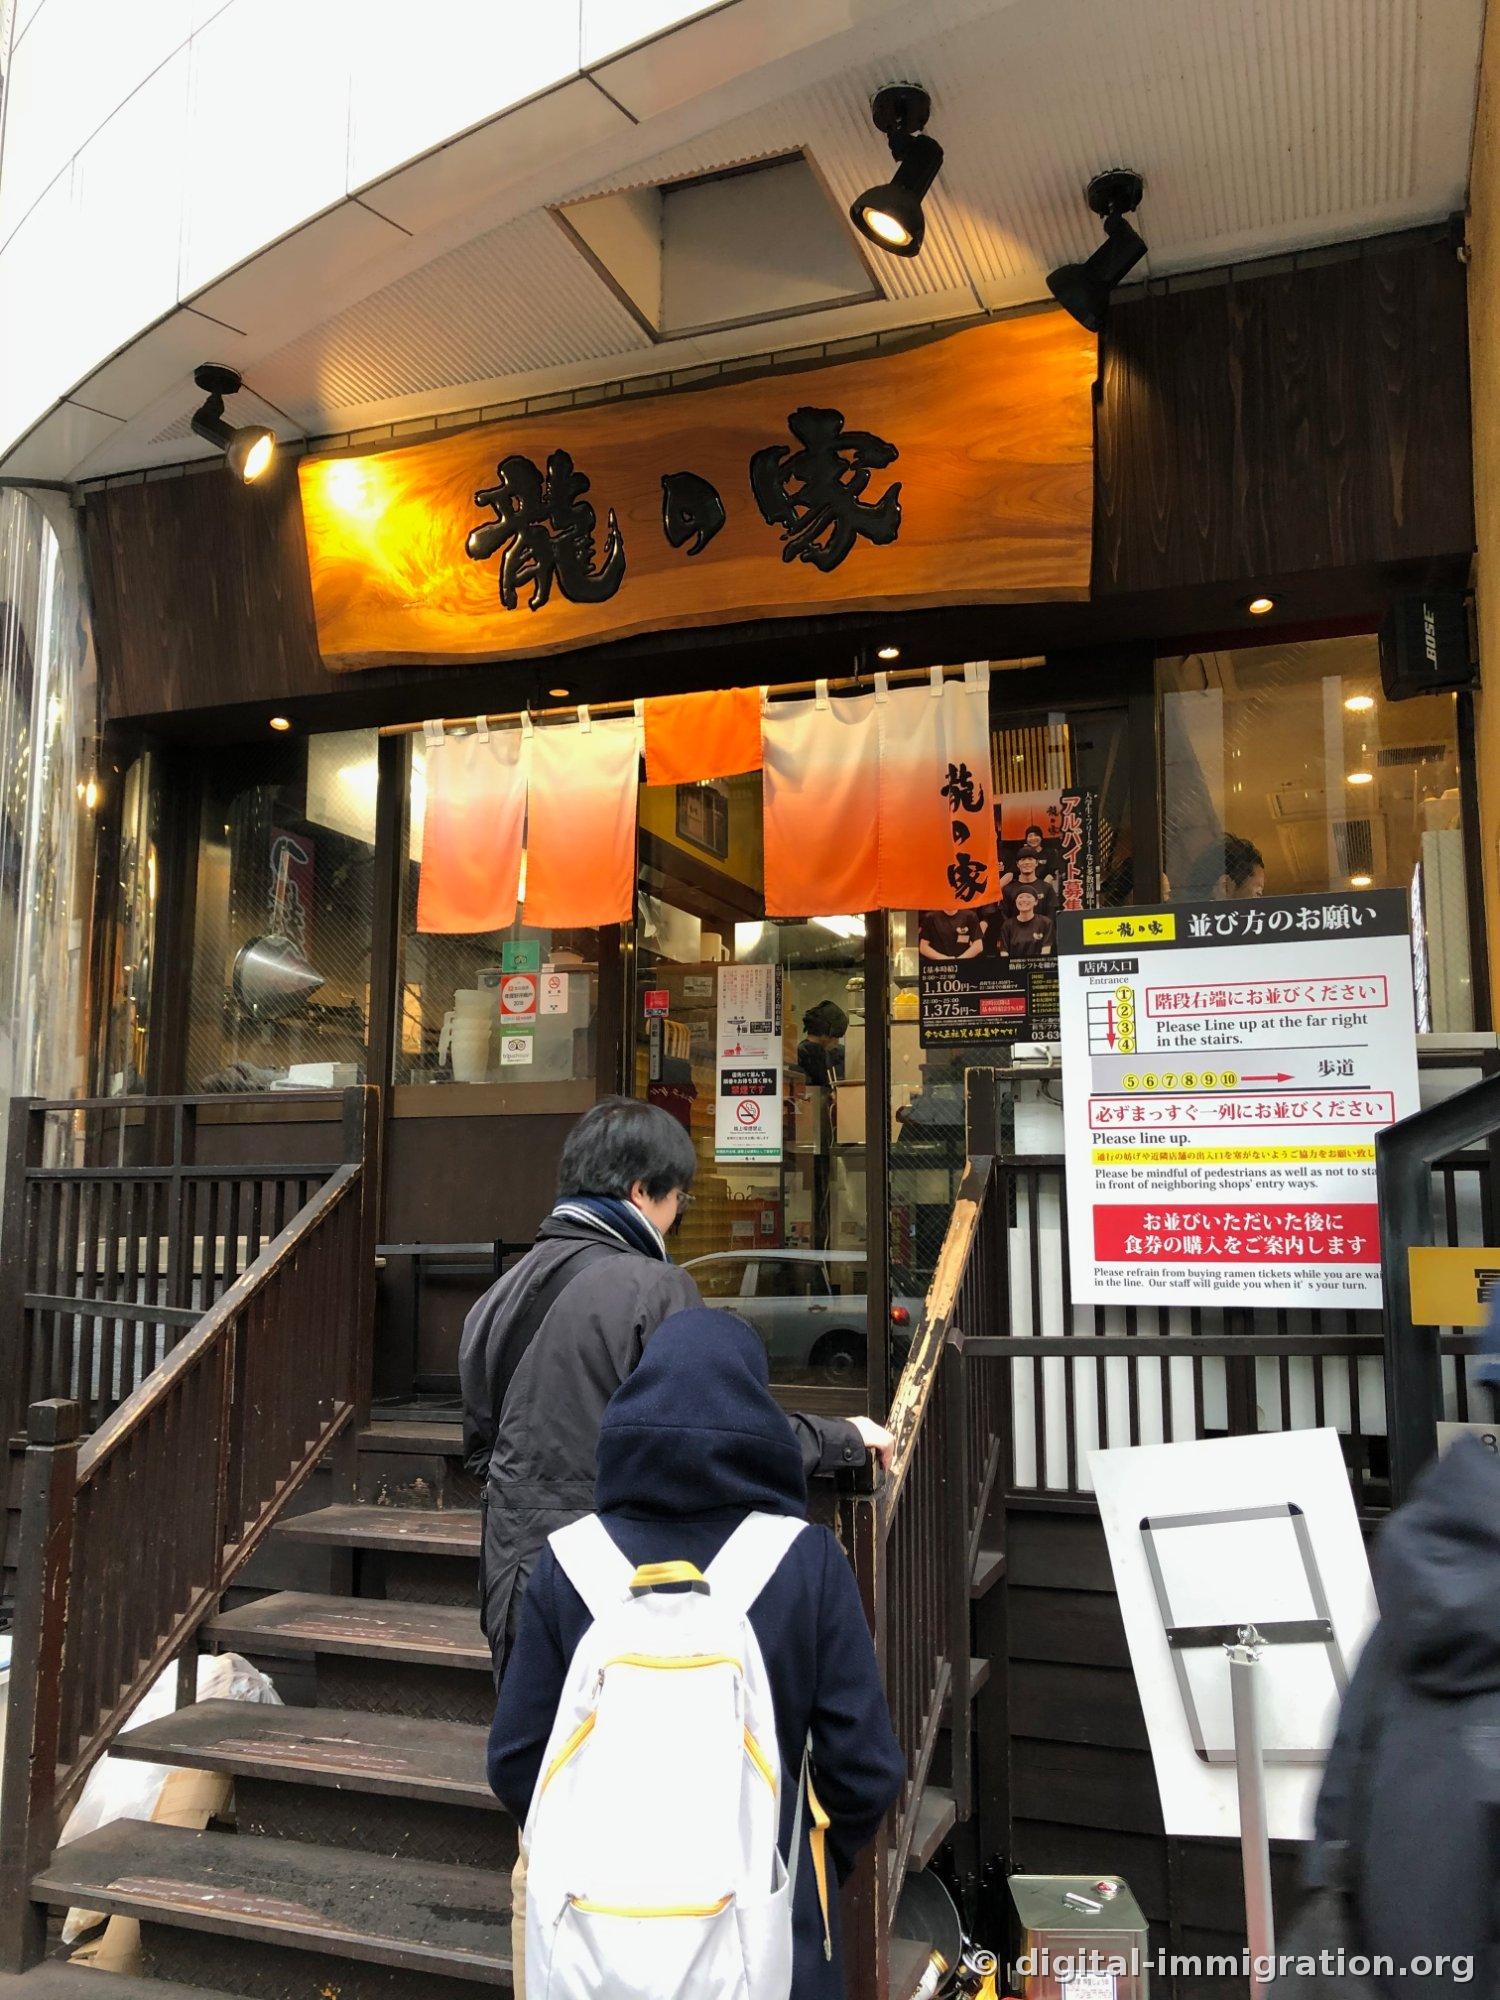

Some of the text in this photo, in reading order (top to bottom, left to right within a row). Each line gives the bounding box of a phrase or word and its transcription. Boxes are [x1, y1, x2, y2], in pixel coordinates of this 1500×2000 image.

[465, 406, 903, 611] 龍の家
[1423, 603, 1438, 670] BOSE
[940, 762, 988, 902] 龍の家
[1117, 920, 1163, 938] 龍の家
[1187, 904, 1377, 938] 並び方のお願い
[1084, 961, 1132, 974] 店内入口
[1089, 976, 1129, 985] Entrance
[1155, 984, 1376, 1010] 階段右端にお並びください
[1156, 1013, 1368, 1033] Please Line up at the far right
[1157, 1033, 1243, 1047] in the stairs.
[1319, 1059, 1355, 1078] 歩道
[1095, 1100, 1383, 1122] 必ずまっすぐ一列にお並びください
[1092, 1132, 1191, 1146] Please line up.
[1095, 1169, 1129, 1178] Please
[1131, 1168, 1144, 1178] be
[1146, 1168, 1188, 1178] mindful
[1190, 1168, 1202, 1178] of
[1204, 1167, 1267, 1180] pedestrians
[1270, 1168, 1282, 1176] as
[1285, 1166, 1307, 1176] well
[1310, 1168, 1322, 1176] as
[1325, 1167, 1344, 1176] not
[1347, 1167, 1359, 1176] to
[1095, 1180, 1106, 1189] in
[1108, 1179, 1135, 1189] front
[1137, 1179, 1149, 1189] of
[1151, 1179, 1217, 1191] neighboring
[1255, 1181, 1285, 1191] entry
[1288, 1181, 1319, 1191] ways.
[1143, 1211, 1344, 1231] お並びいただいた後に
[1124, 1235, 1367, 1255] 食券の購入をご案内します
[1094, 1267, 1124, 1277] Please
[1126, 1268, 1160, 1277] refrain
[1162, 1268, 1186, 1278] from
[1187, 1269, 1222, 1280] buying
[1223, 1270, 1256, 1278] ramen
[1258, 1269, 1292, 1278] tickets
[1294, 1269, 1321, 1279] while
[1323, 1272, 1343, 1281] you
[1094, 1278, 1104, 1287] in
[1106, 1278, 1121, 1287] the
[1124, 1278, 1144, 1287] line.
[1149, 1279, 1167, 1288] Our
[1169, 1278, 1191, 1288] staff
[1193, 1278, 1211, 1288] will
[1213, 1279, 1240, 1290] guide
[1242, 1281, 1262, 1291] you
[1264, 1280, 1291, 1289] when
[1315, 1282, 1340, 1292] your
[1342, 1282, 1367, 1290] turn.
